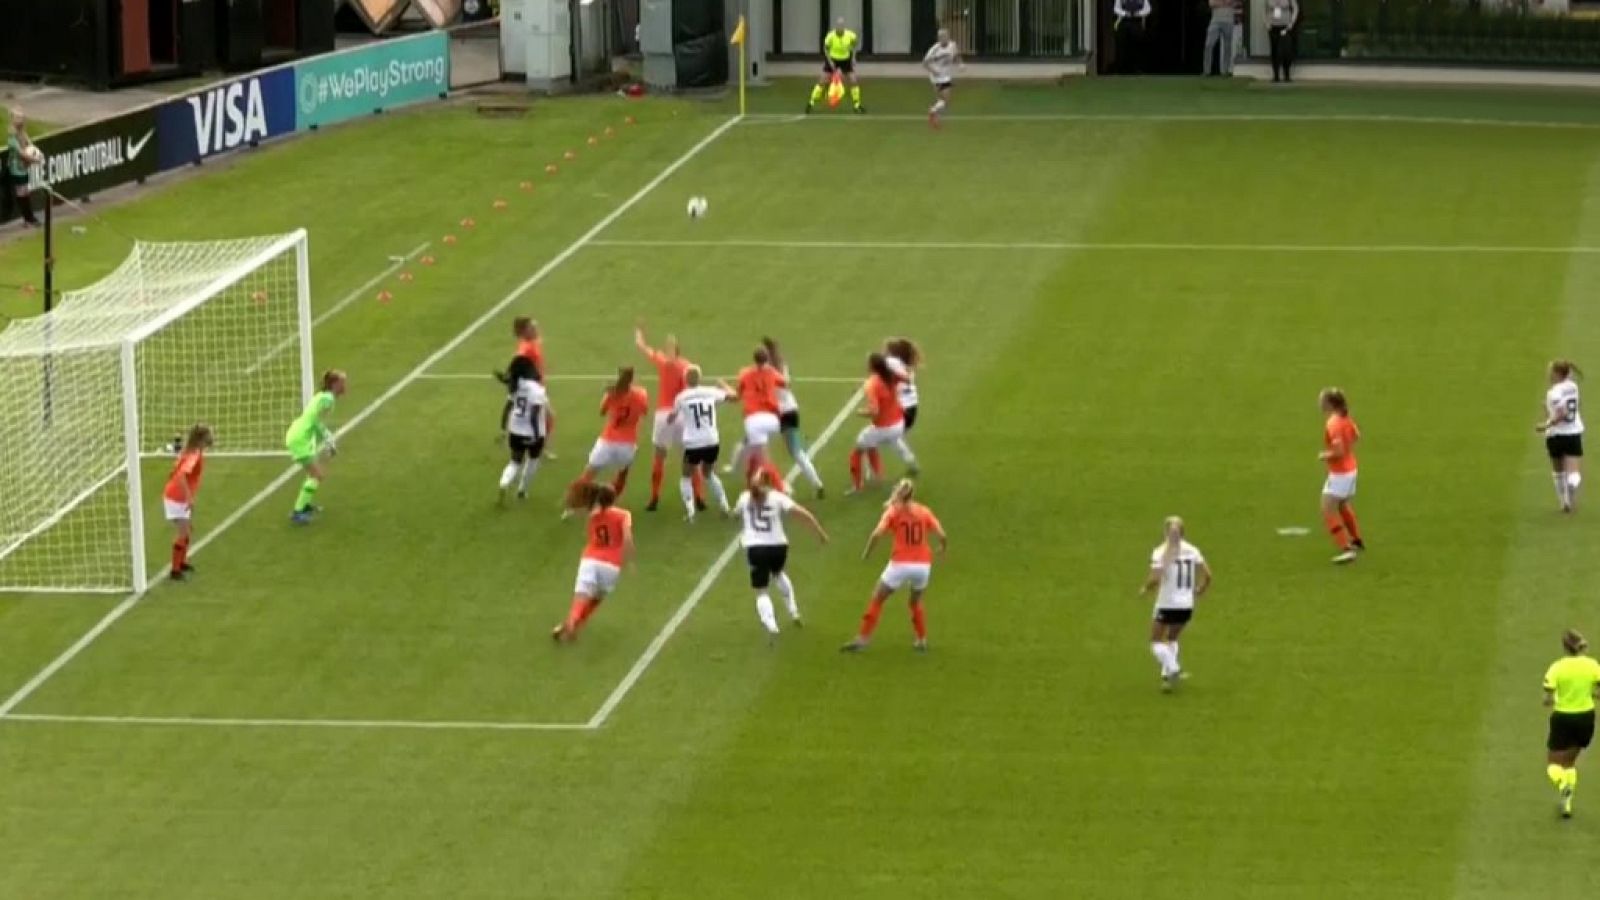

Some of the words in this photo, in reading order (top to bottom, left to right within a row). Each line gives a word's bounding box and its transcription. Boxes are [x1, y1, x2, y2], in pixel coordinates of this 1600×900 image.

[187, 78, 267, 155] VISA
[688, 402, 713, 428] 14
[900, 521, 923, 546] 10
[1174, 559, 1192, 589] 11
